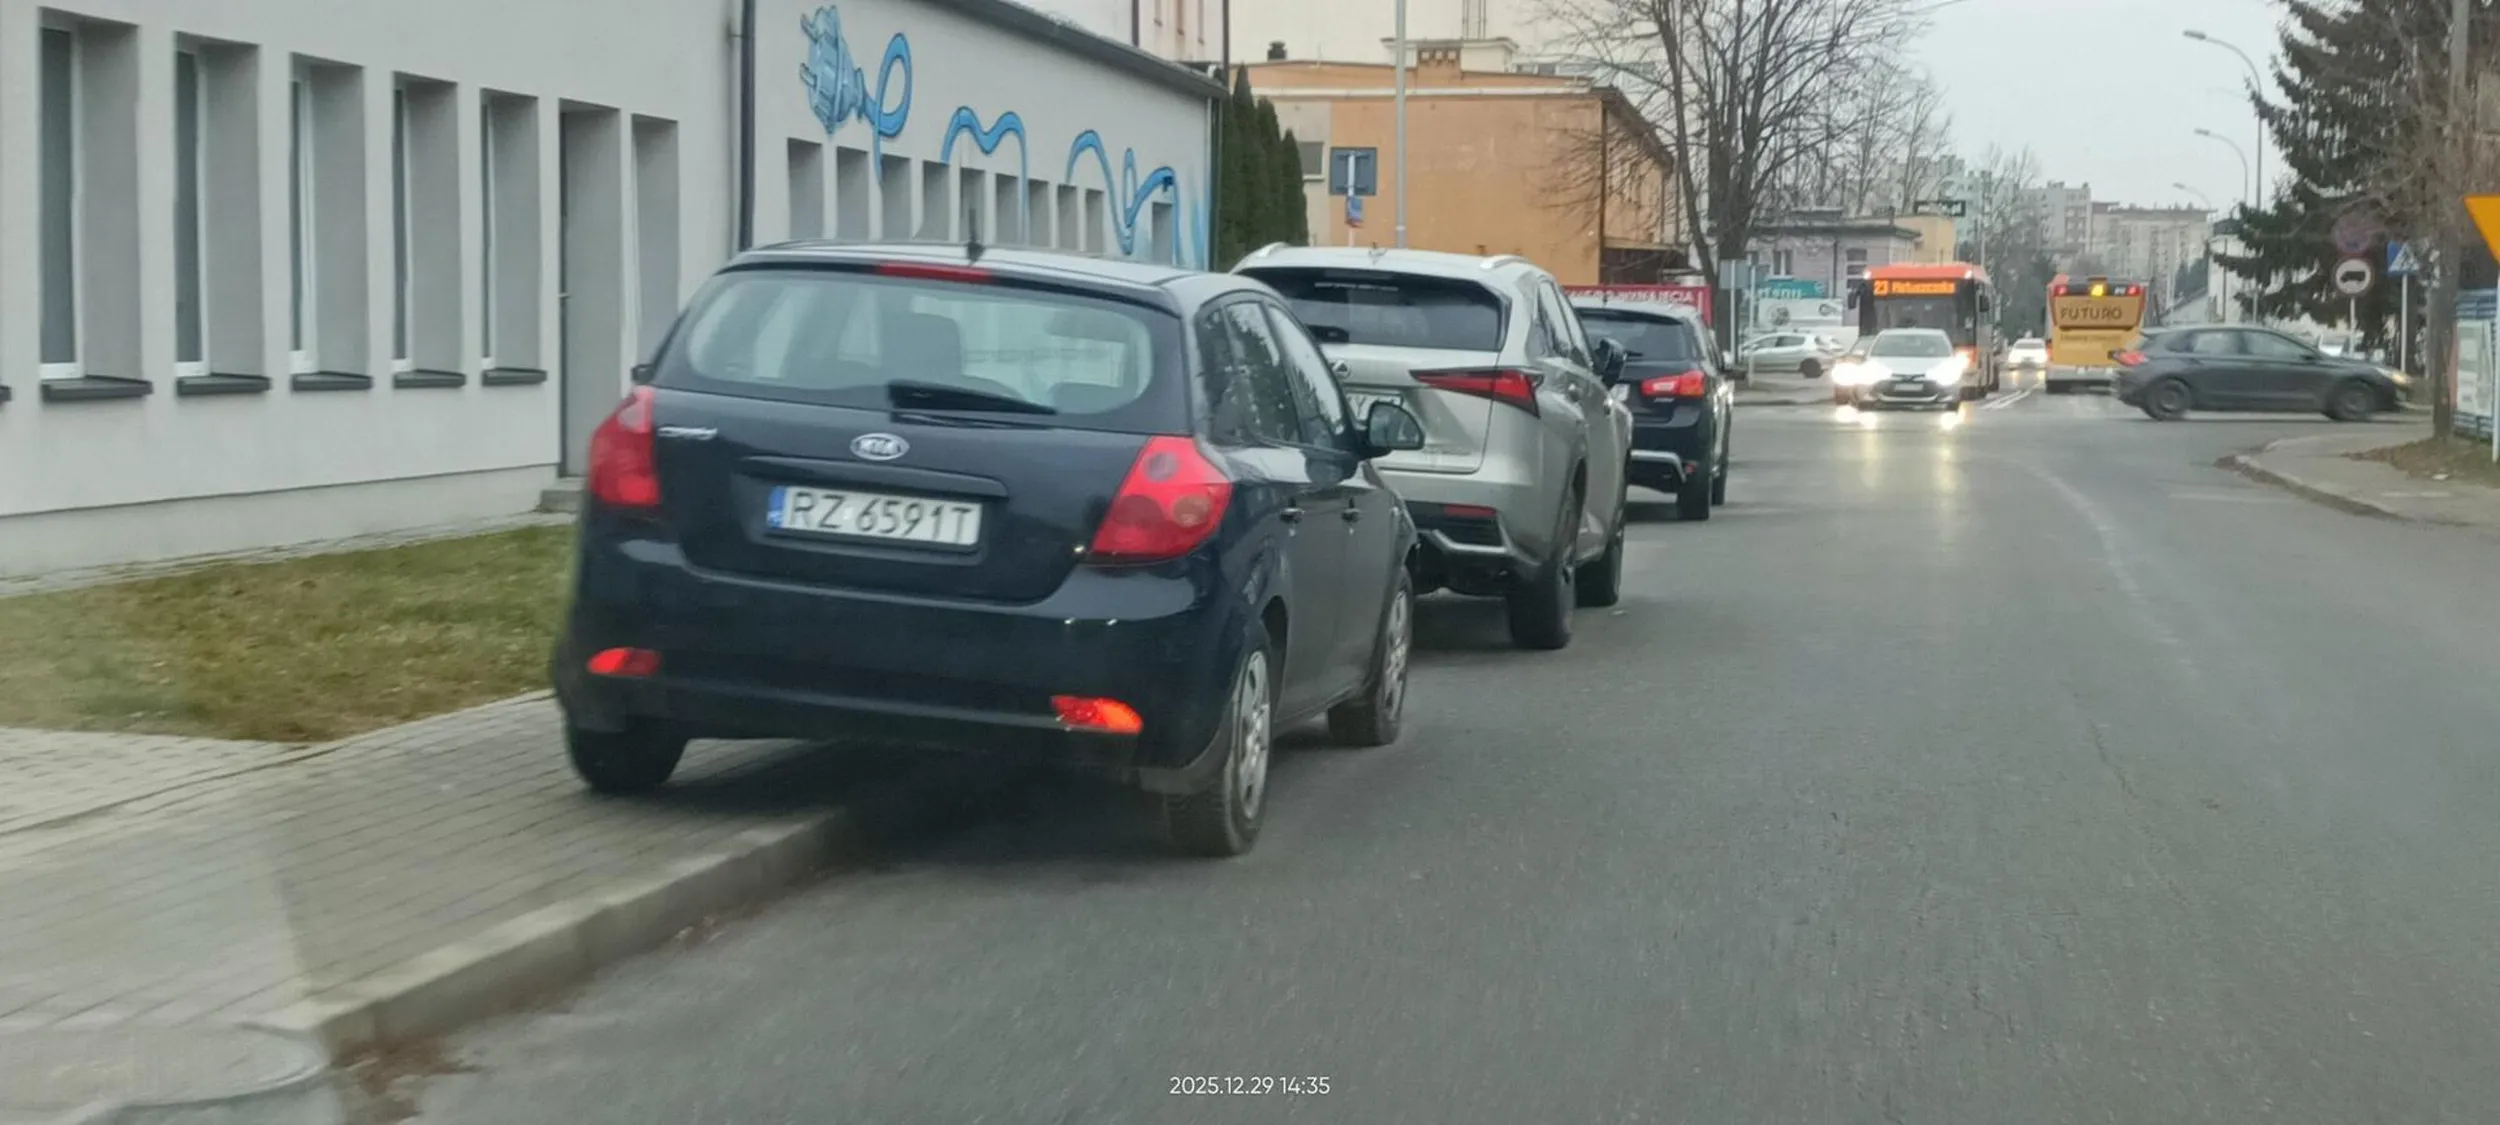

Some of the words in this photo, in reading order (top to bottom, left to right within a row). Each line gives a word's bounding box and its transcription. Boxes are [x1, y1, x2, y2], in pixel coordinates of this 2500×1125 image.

[1873, 279, 1888, 296] 23
[2060, 306, 2123, 320] FUTURO
[788, 491, 846, 529] RZ
[855, 497, 973, 545] 6591T
